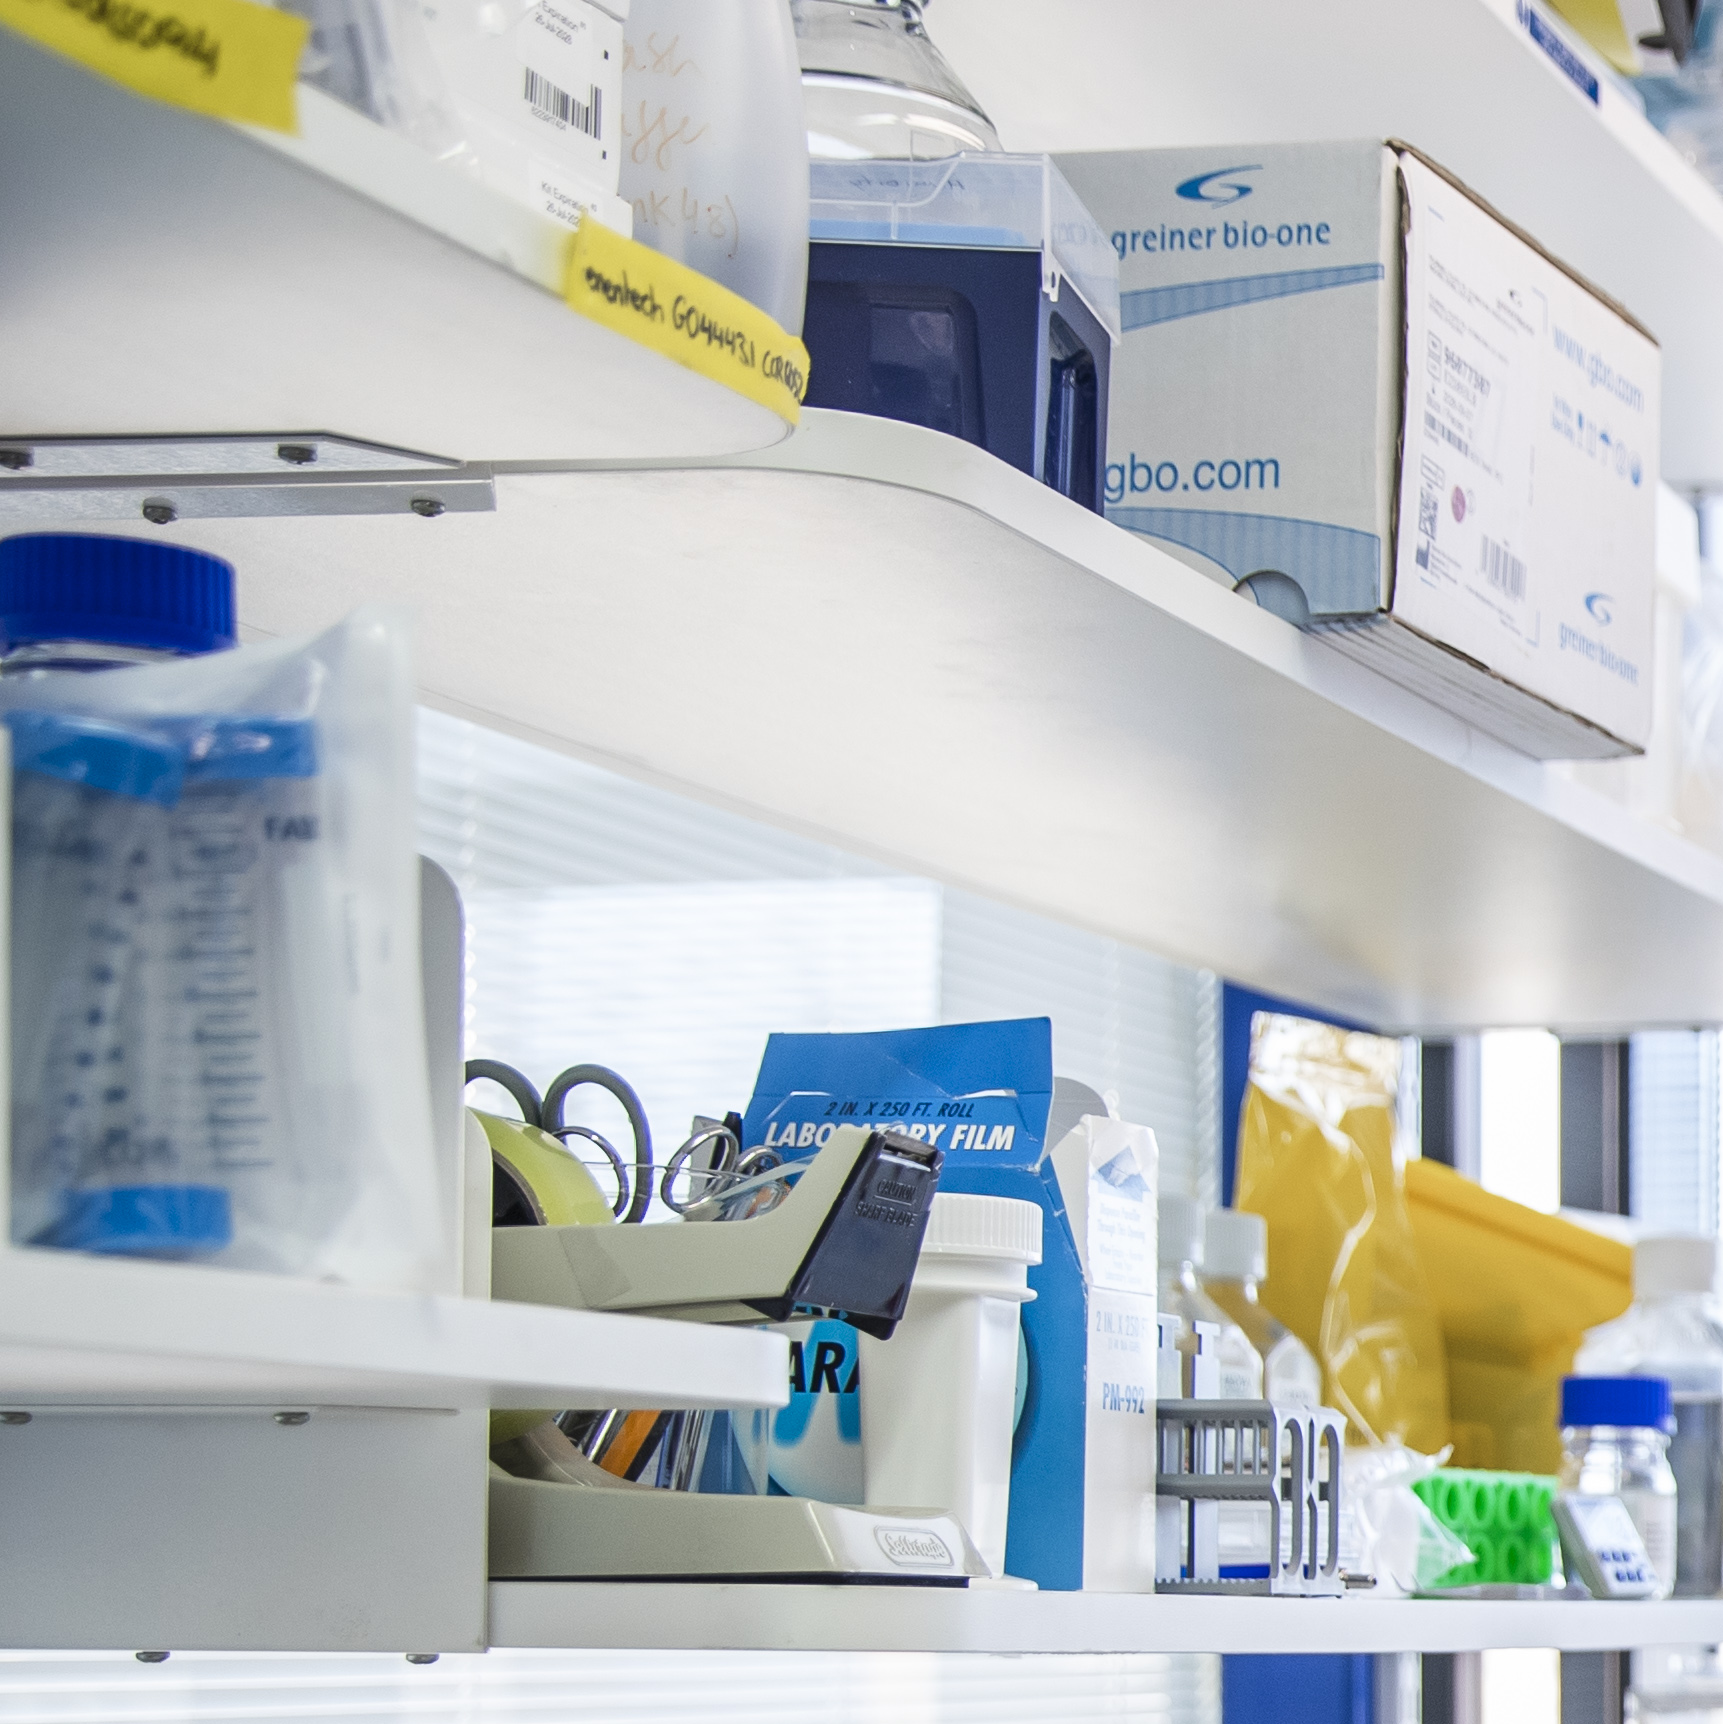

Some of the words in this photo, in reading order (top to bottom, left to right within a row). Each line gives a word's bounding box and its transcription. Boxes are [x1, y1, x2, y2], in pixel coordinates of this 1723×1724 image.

[1111, 223, 1216, 262] greiner
[1224, 220, 1331, 253] bio-one
[823, 1101, 838, 1117] 2
[865, 1101, 878, 1117] X
[881, 1102, 908, 1117] 250
[913, 1102, 932, 1118] FT.
[937, 1102, 975, 1119] ROLL
[949, 1124, 1016, 1151] FILM
[1102, 1382, 1146, 1415] PM-992
